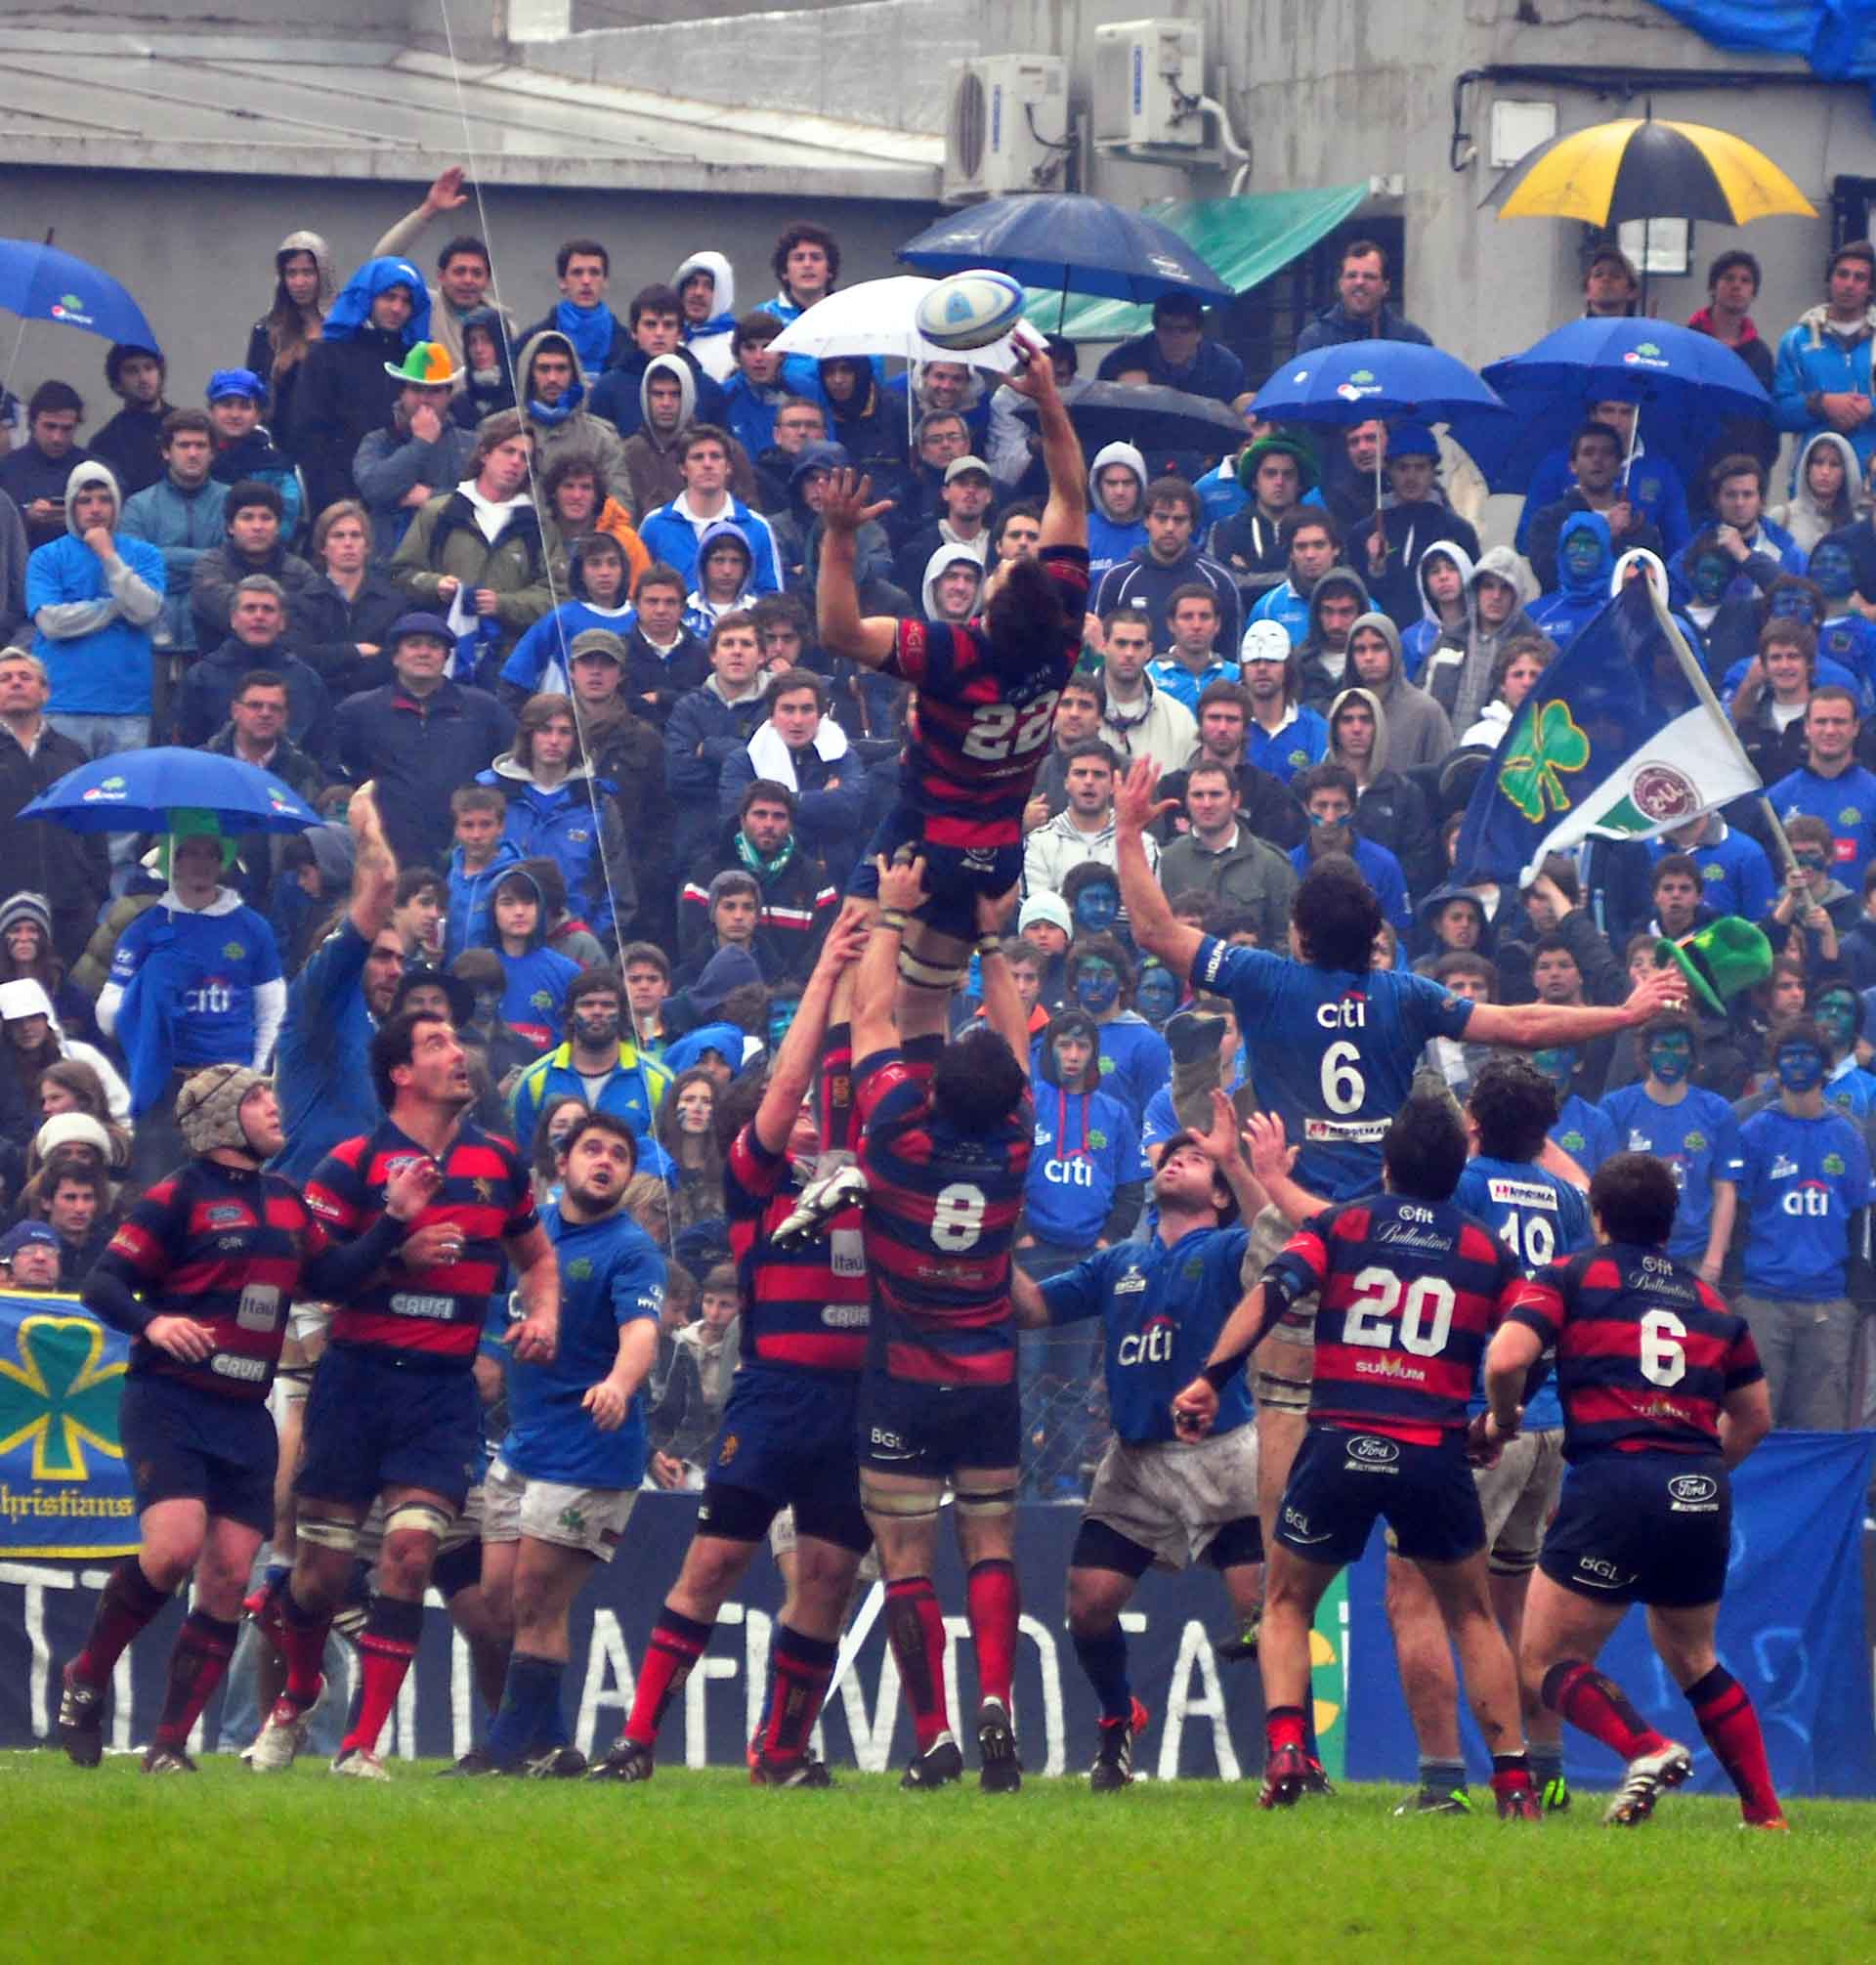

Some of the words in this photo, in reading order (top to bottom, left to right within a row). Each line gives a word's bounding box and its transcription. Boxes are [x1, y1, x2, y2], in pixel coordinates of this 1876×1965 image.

[961, 690, 1060, 760] 22
[1321, 1041, 1366, 1114] 6
[1045, 1156, 1092, 1186] citi
[930, 1182, 986, 1252] 8
[1499, 1212, 1556, 1266] 10
[1342, 1266, 1457, 1358] 20
[1118, 1325, 1172, 1366] citi
[1641, 1308, 1687, 1388] 6
[1358, 1439, 1387, 1458] Ford
[1, 1484, 134, 1524] hristians
[1678, 1479, 1707, 1496] Ford
[1285, 1507, 1309, 1535] BGL
[1579, 1556, 1619, 1581] BGL
